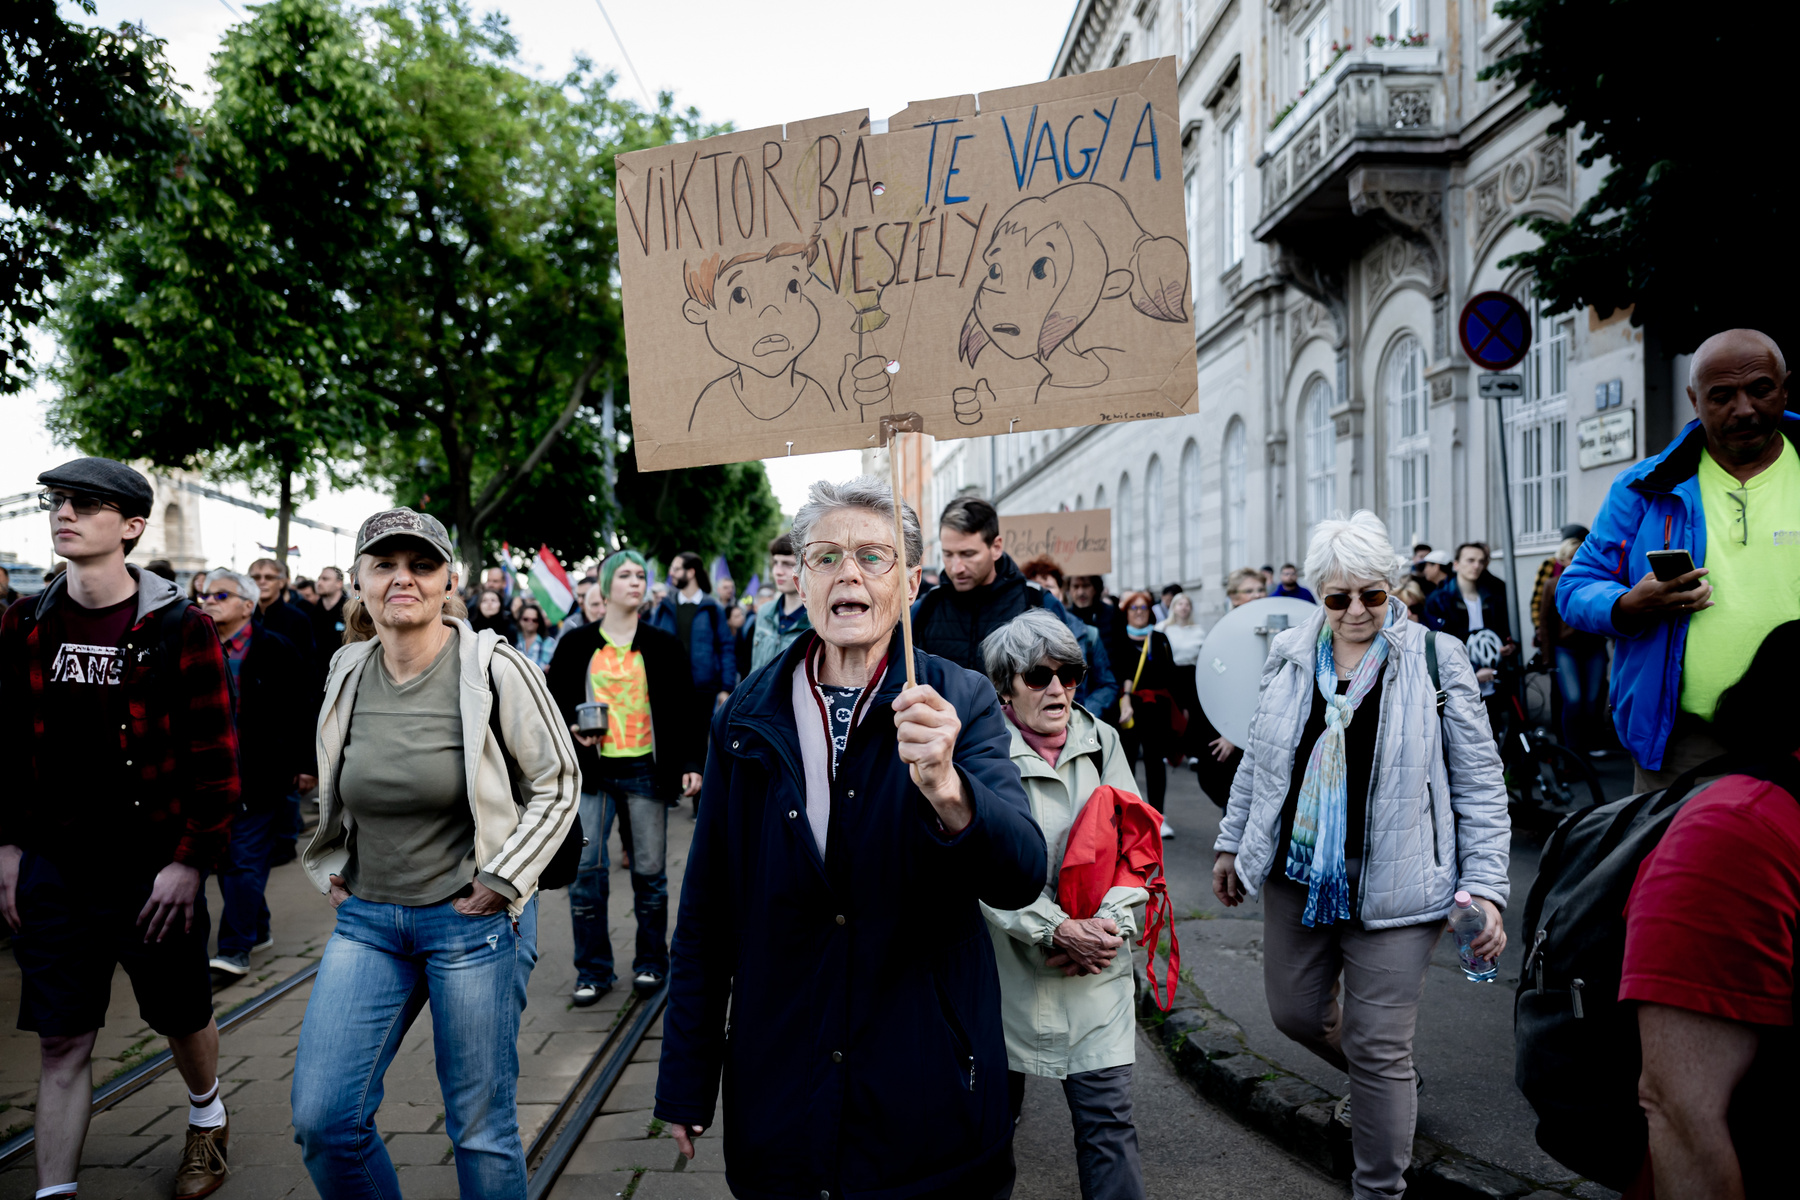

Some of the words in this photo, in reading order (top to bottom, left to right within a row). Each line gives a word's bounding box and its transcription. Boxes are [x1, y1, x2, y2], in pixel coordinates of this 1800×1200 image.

[818, 116, 875, 221] BÁ
[913, 118, 976, 207] TE
[1001, 97, 1118, 191] VAGY
[1120, 102, 1162, 182] A
[822, 203, 988, 294] VESZÉLY
[50, 643, 124, 685] VANS
